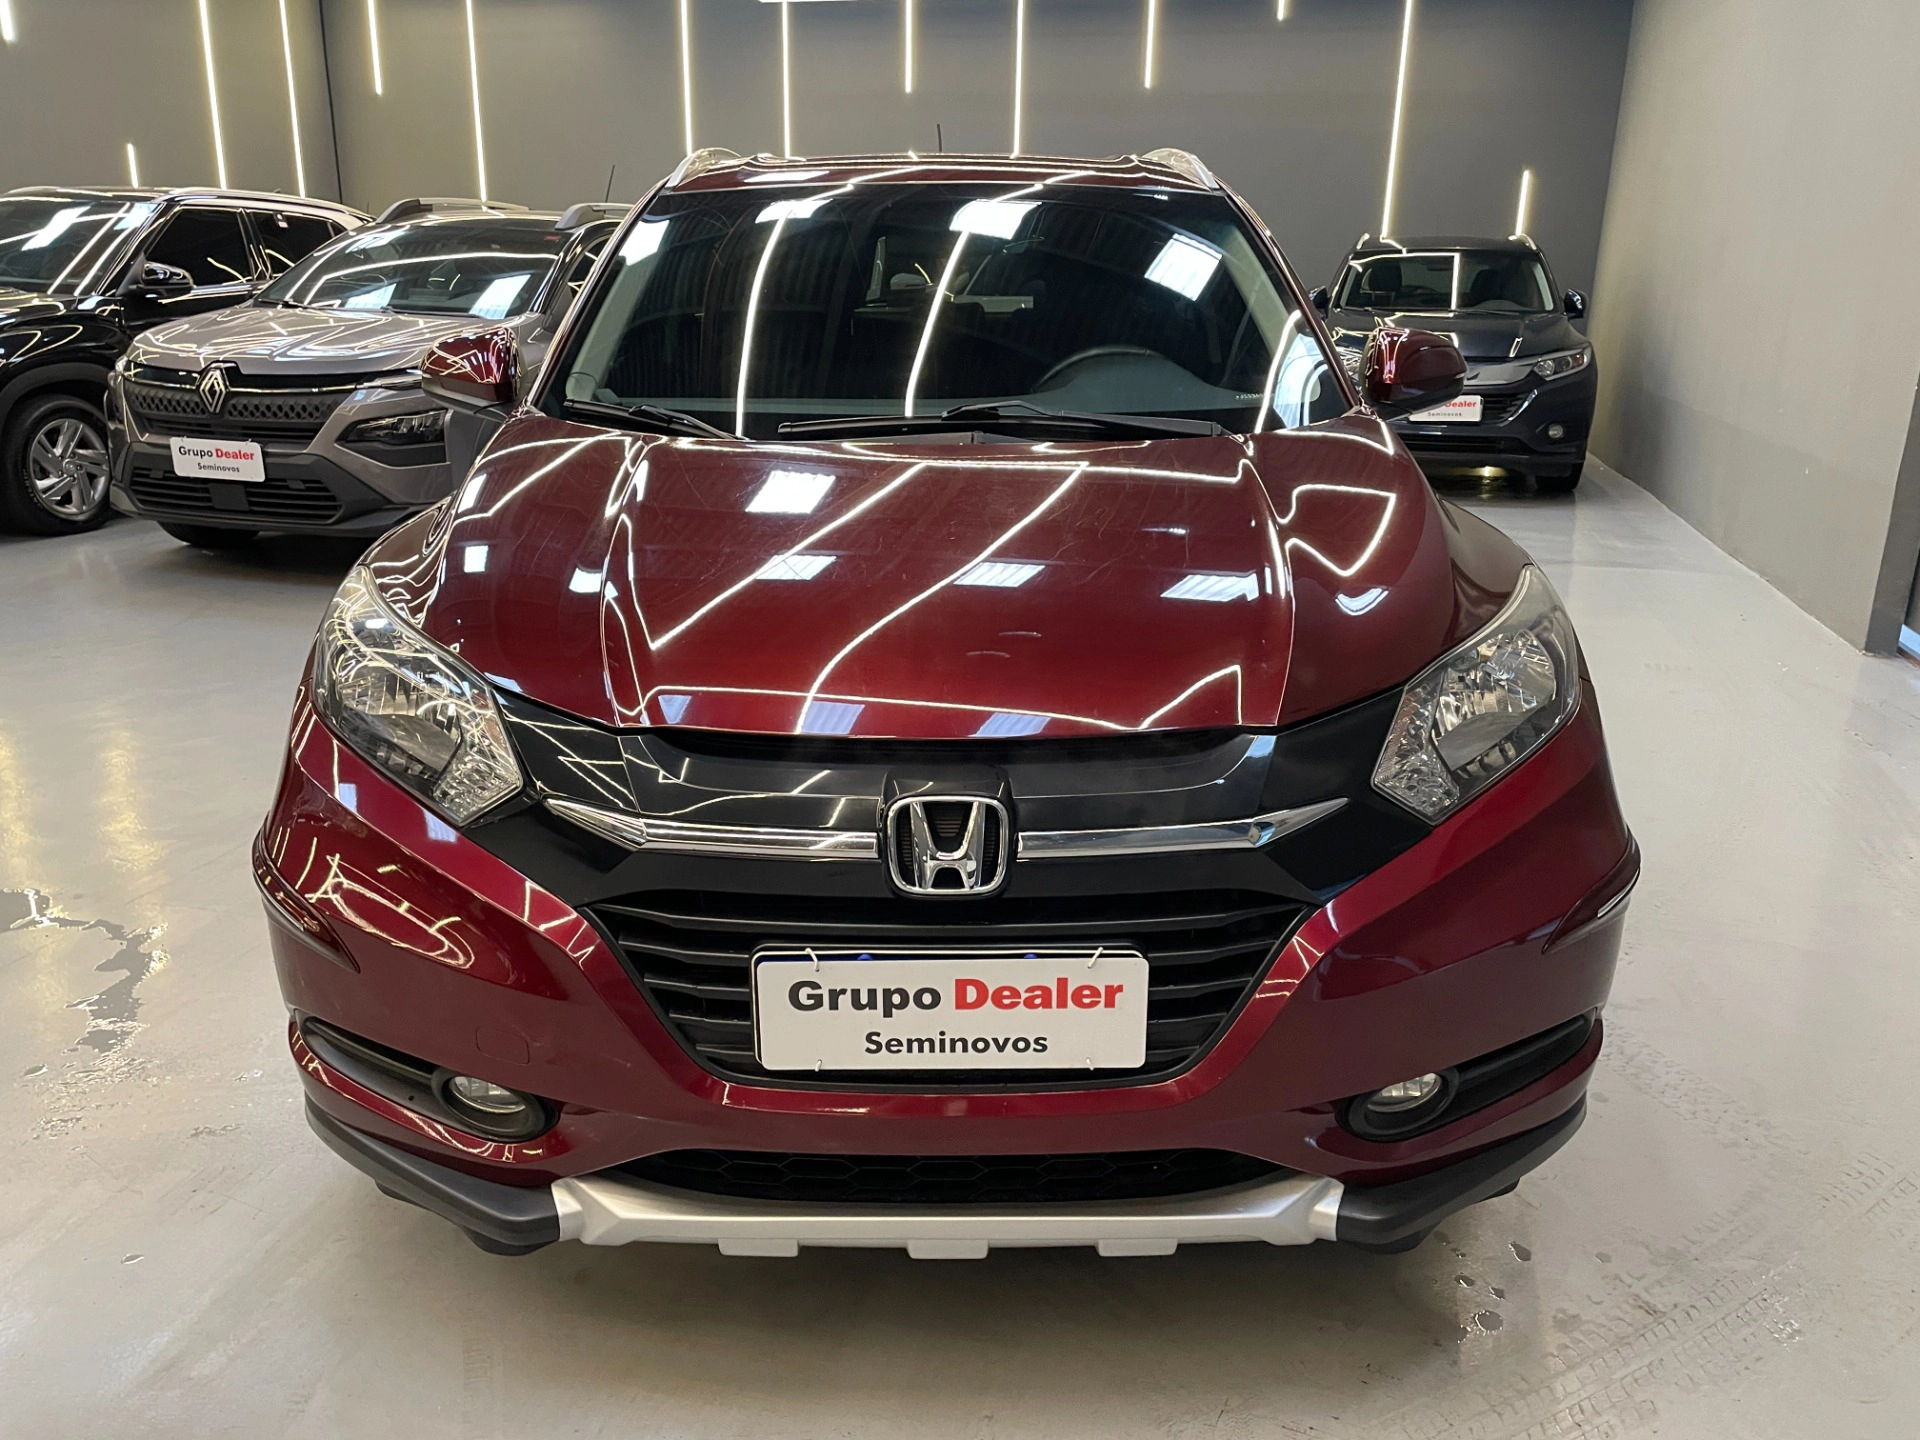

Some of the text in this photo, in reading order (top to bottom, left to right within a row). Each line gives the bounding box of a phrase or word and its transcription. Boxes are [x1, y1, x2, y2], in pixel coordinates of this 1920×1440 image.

[178, 446, 254, 460] Grupo Dealer
[197, 463, 240, 473] Seminovos
[788, 977, 1124, 1018] Grupo Dealer
[864, 1031, 1048, 1055] Seminovos
